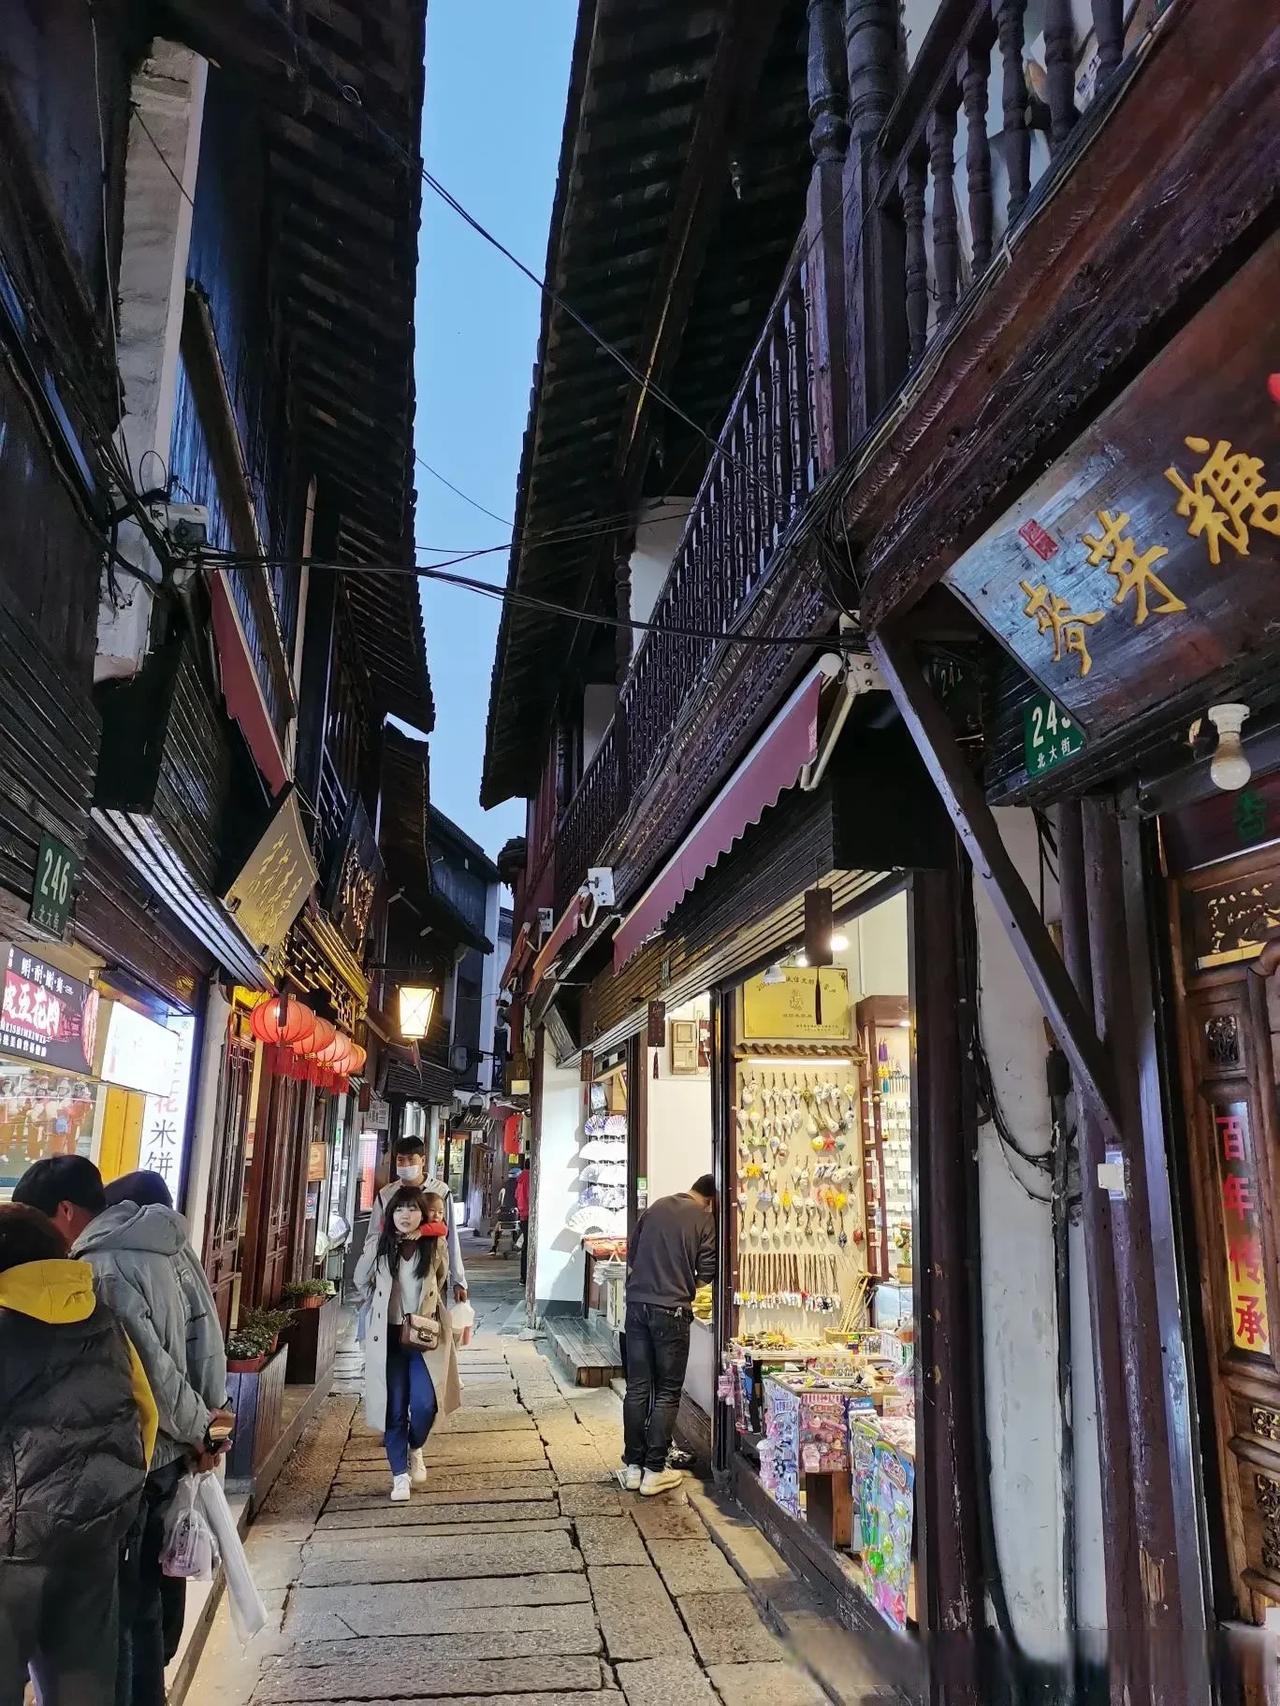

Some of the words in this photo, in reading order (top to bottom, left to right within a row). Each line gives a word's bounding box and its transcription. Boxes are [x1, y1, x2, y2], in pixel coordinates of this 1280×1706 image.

[1032, 698, 1072, 748] 24
[1036, 736, 1073, 769] 北大街
[40, 847, 71, 905] 246
[1216, 1115, 1269, 1346] 百年传承
